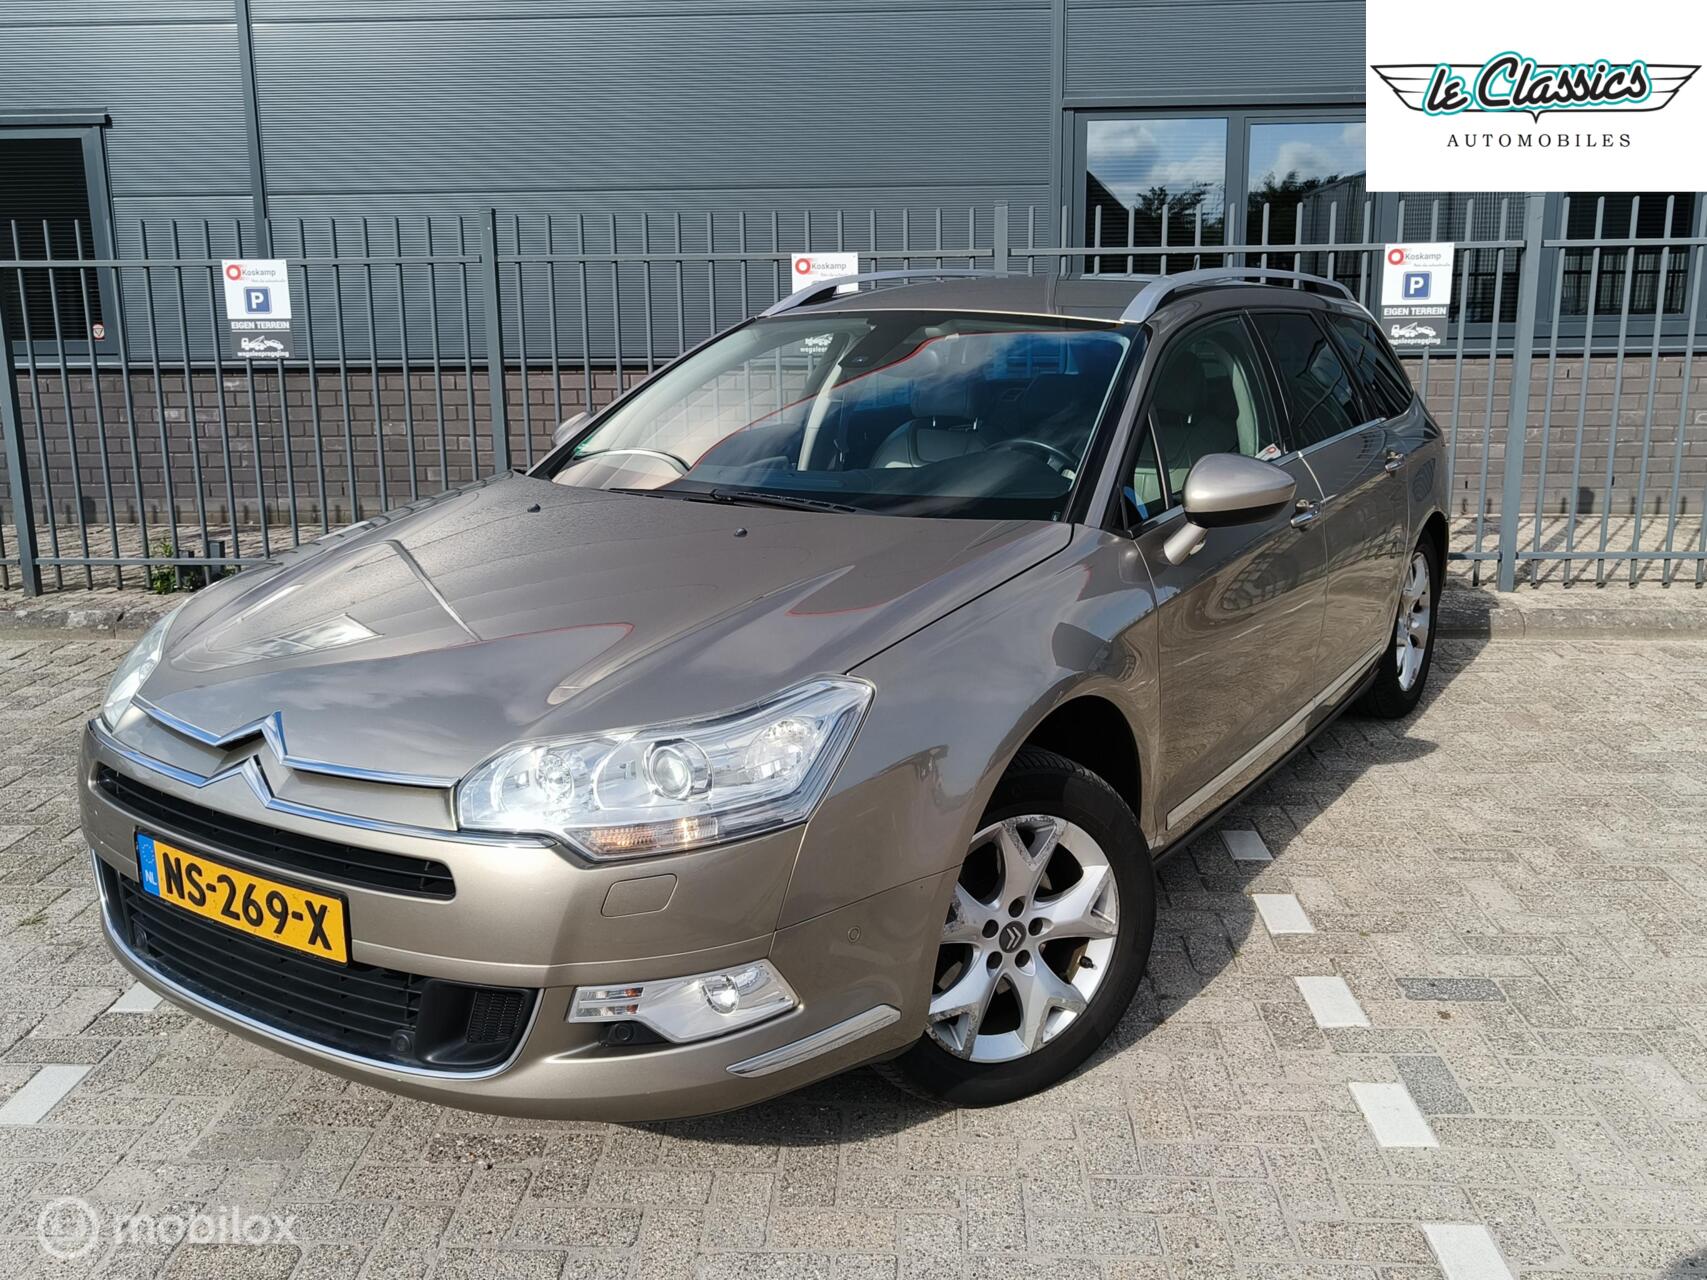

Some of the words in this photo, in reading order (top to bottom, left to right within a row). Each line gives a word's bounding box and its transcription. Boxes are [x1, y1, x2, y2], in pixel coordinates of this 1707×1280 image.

[242, 268, 276, 276] Koskamp
[811, 262, 847, 270] Koskamp
[1410, 277, 1424, 294] P
[250, 291, 265, 309] P
[1383, 307, 1410, 316] EIGEN
[1411, 307, 1446, 315] TERREIN
[231, 321, 255, 329] EIGEN
[256, 321, 290, 329] TERREIN
[145, 869, 157, 886] NL
[162, 851, 333, 951] NS-269-X
